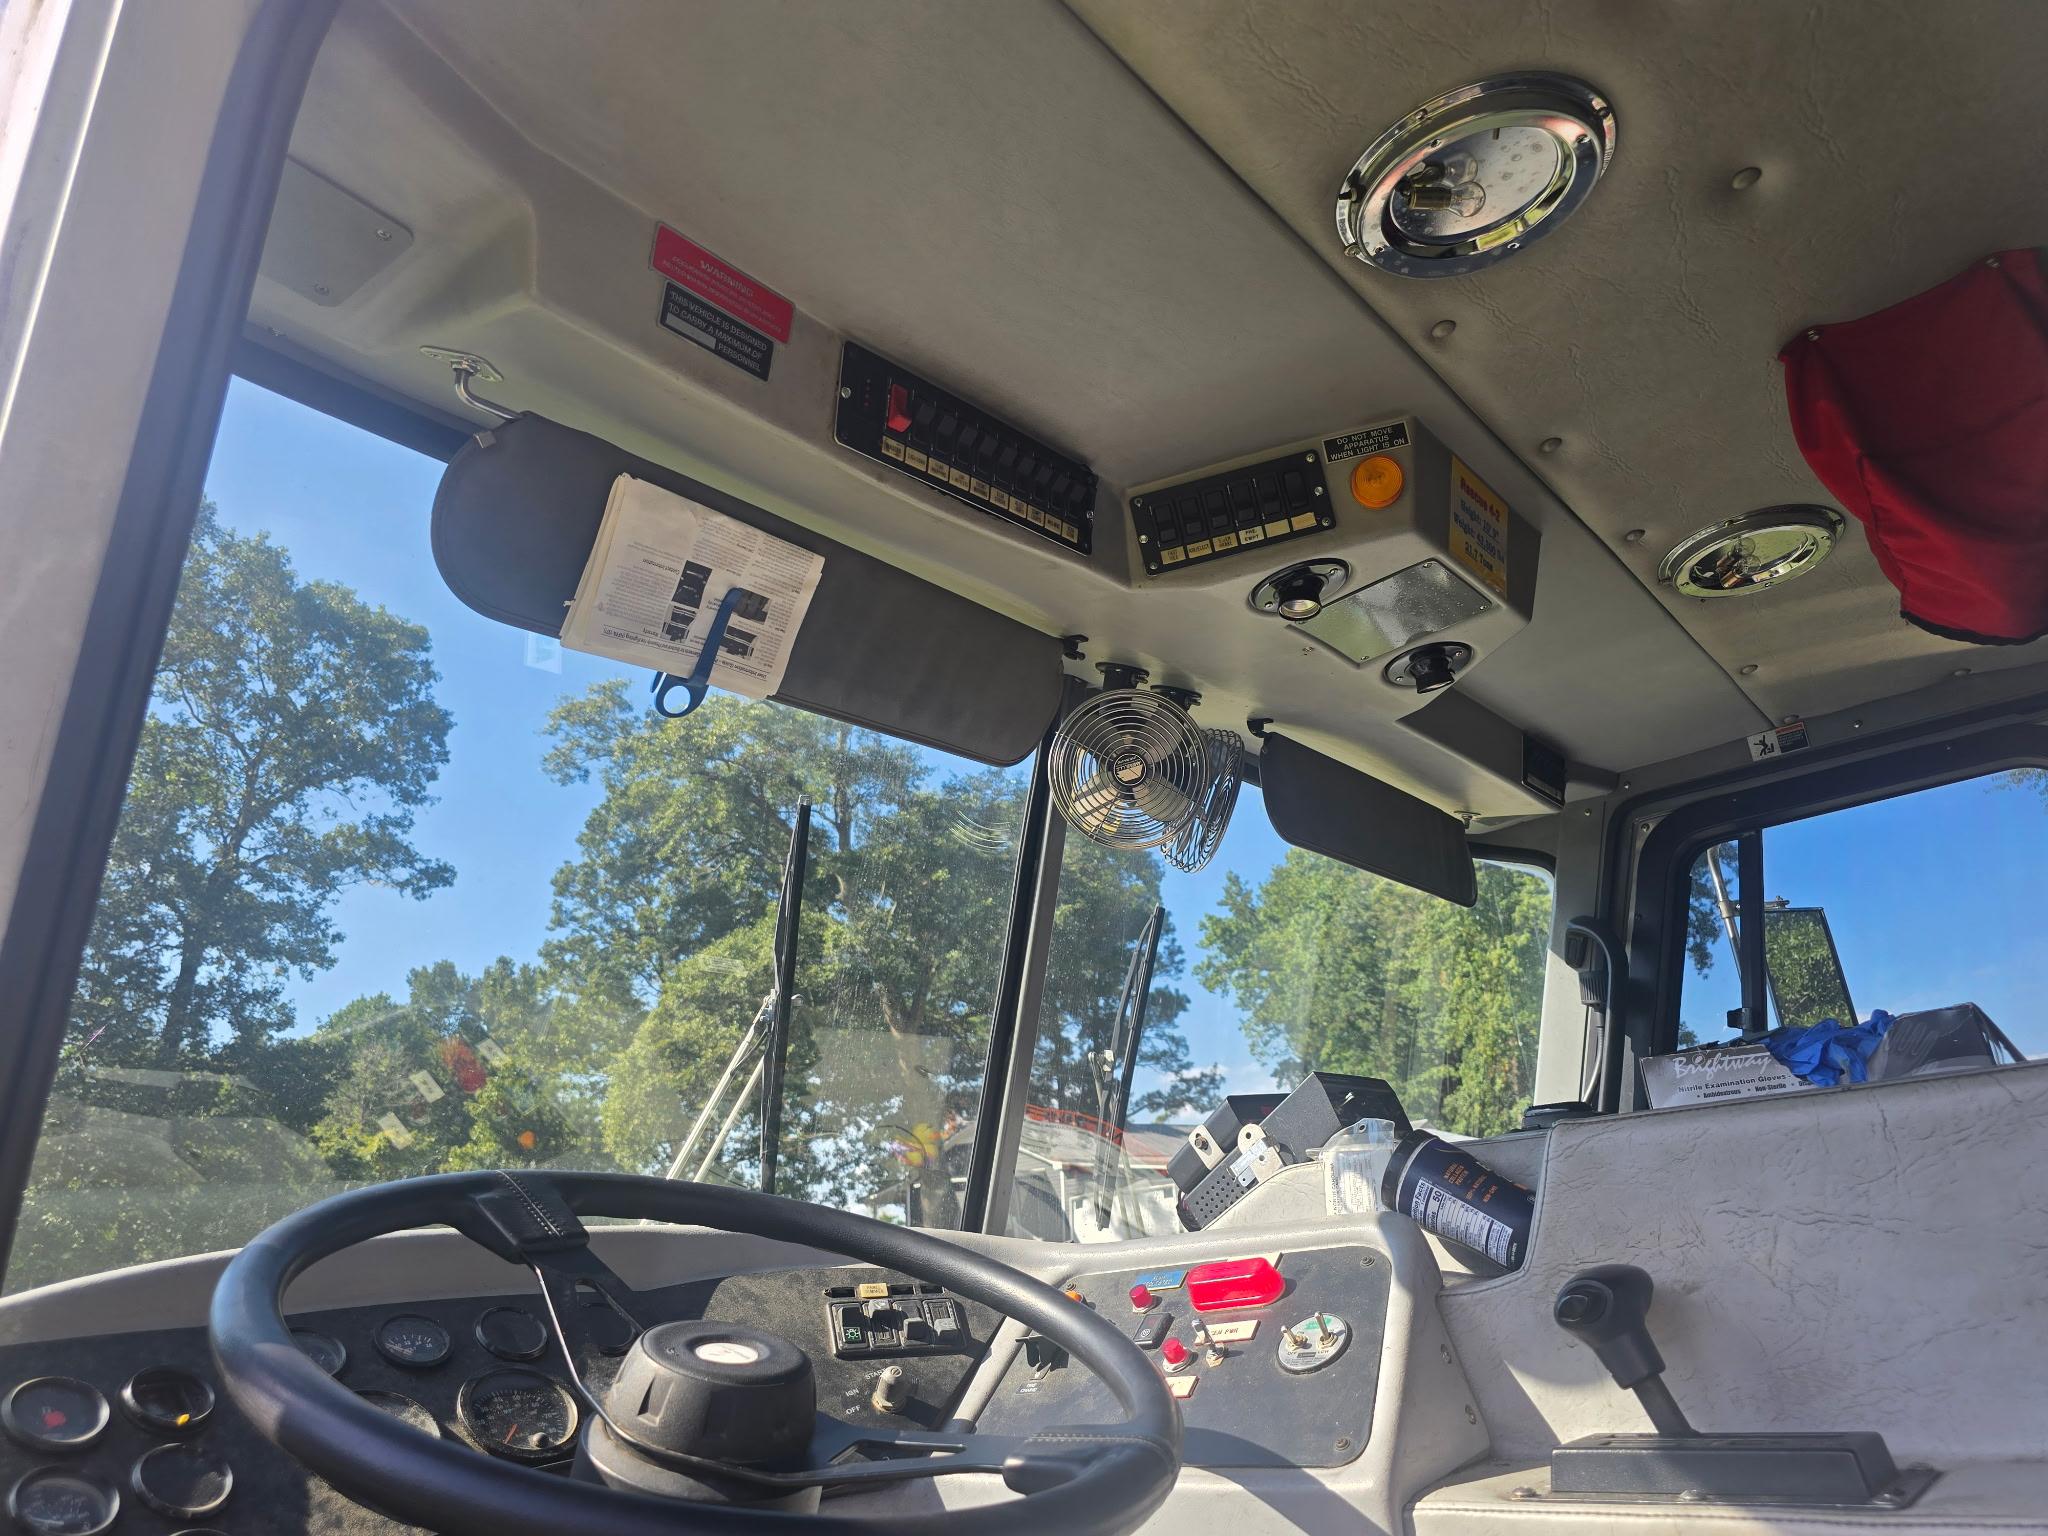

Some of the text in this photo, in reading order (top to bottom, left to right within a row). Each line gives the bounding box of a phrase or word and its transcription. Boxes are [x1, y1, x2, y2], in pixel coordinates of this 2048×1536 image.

[700, 260, 754, 297] WARNING
[669, 303, 680, 315] TO
[681, 310, 708, 329] CARRY
[713, 329, 752, 355] MAXIMUM
[670, 291, 689, 308] THIS
[688, 302, 721, 326] VEHICLE
[730, 324, 768, 351] DESIGNED
[717, 343, 761, 373] PERSONNEL
[1336, 427, 1393, 445] DO NOT MOVE
[1343, 435, 1389, 451] APPARATUS
[1330, 438, 1405, 461] WHEN LIGHT IS ON
[1672, 1052, 1772, 1080] Brightway
[1678, 1073, 1787, 1093] Nitrile Examination Gloves
[1432, 1190, 1442, 1203] 50
[845, 1388, 859, 1397] IGN
[845, 1405, 861, 1415] OFF
